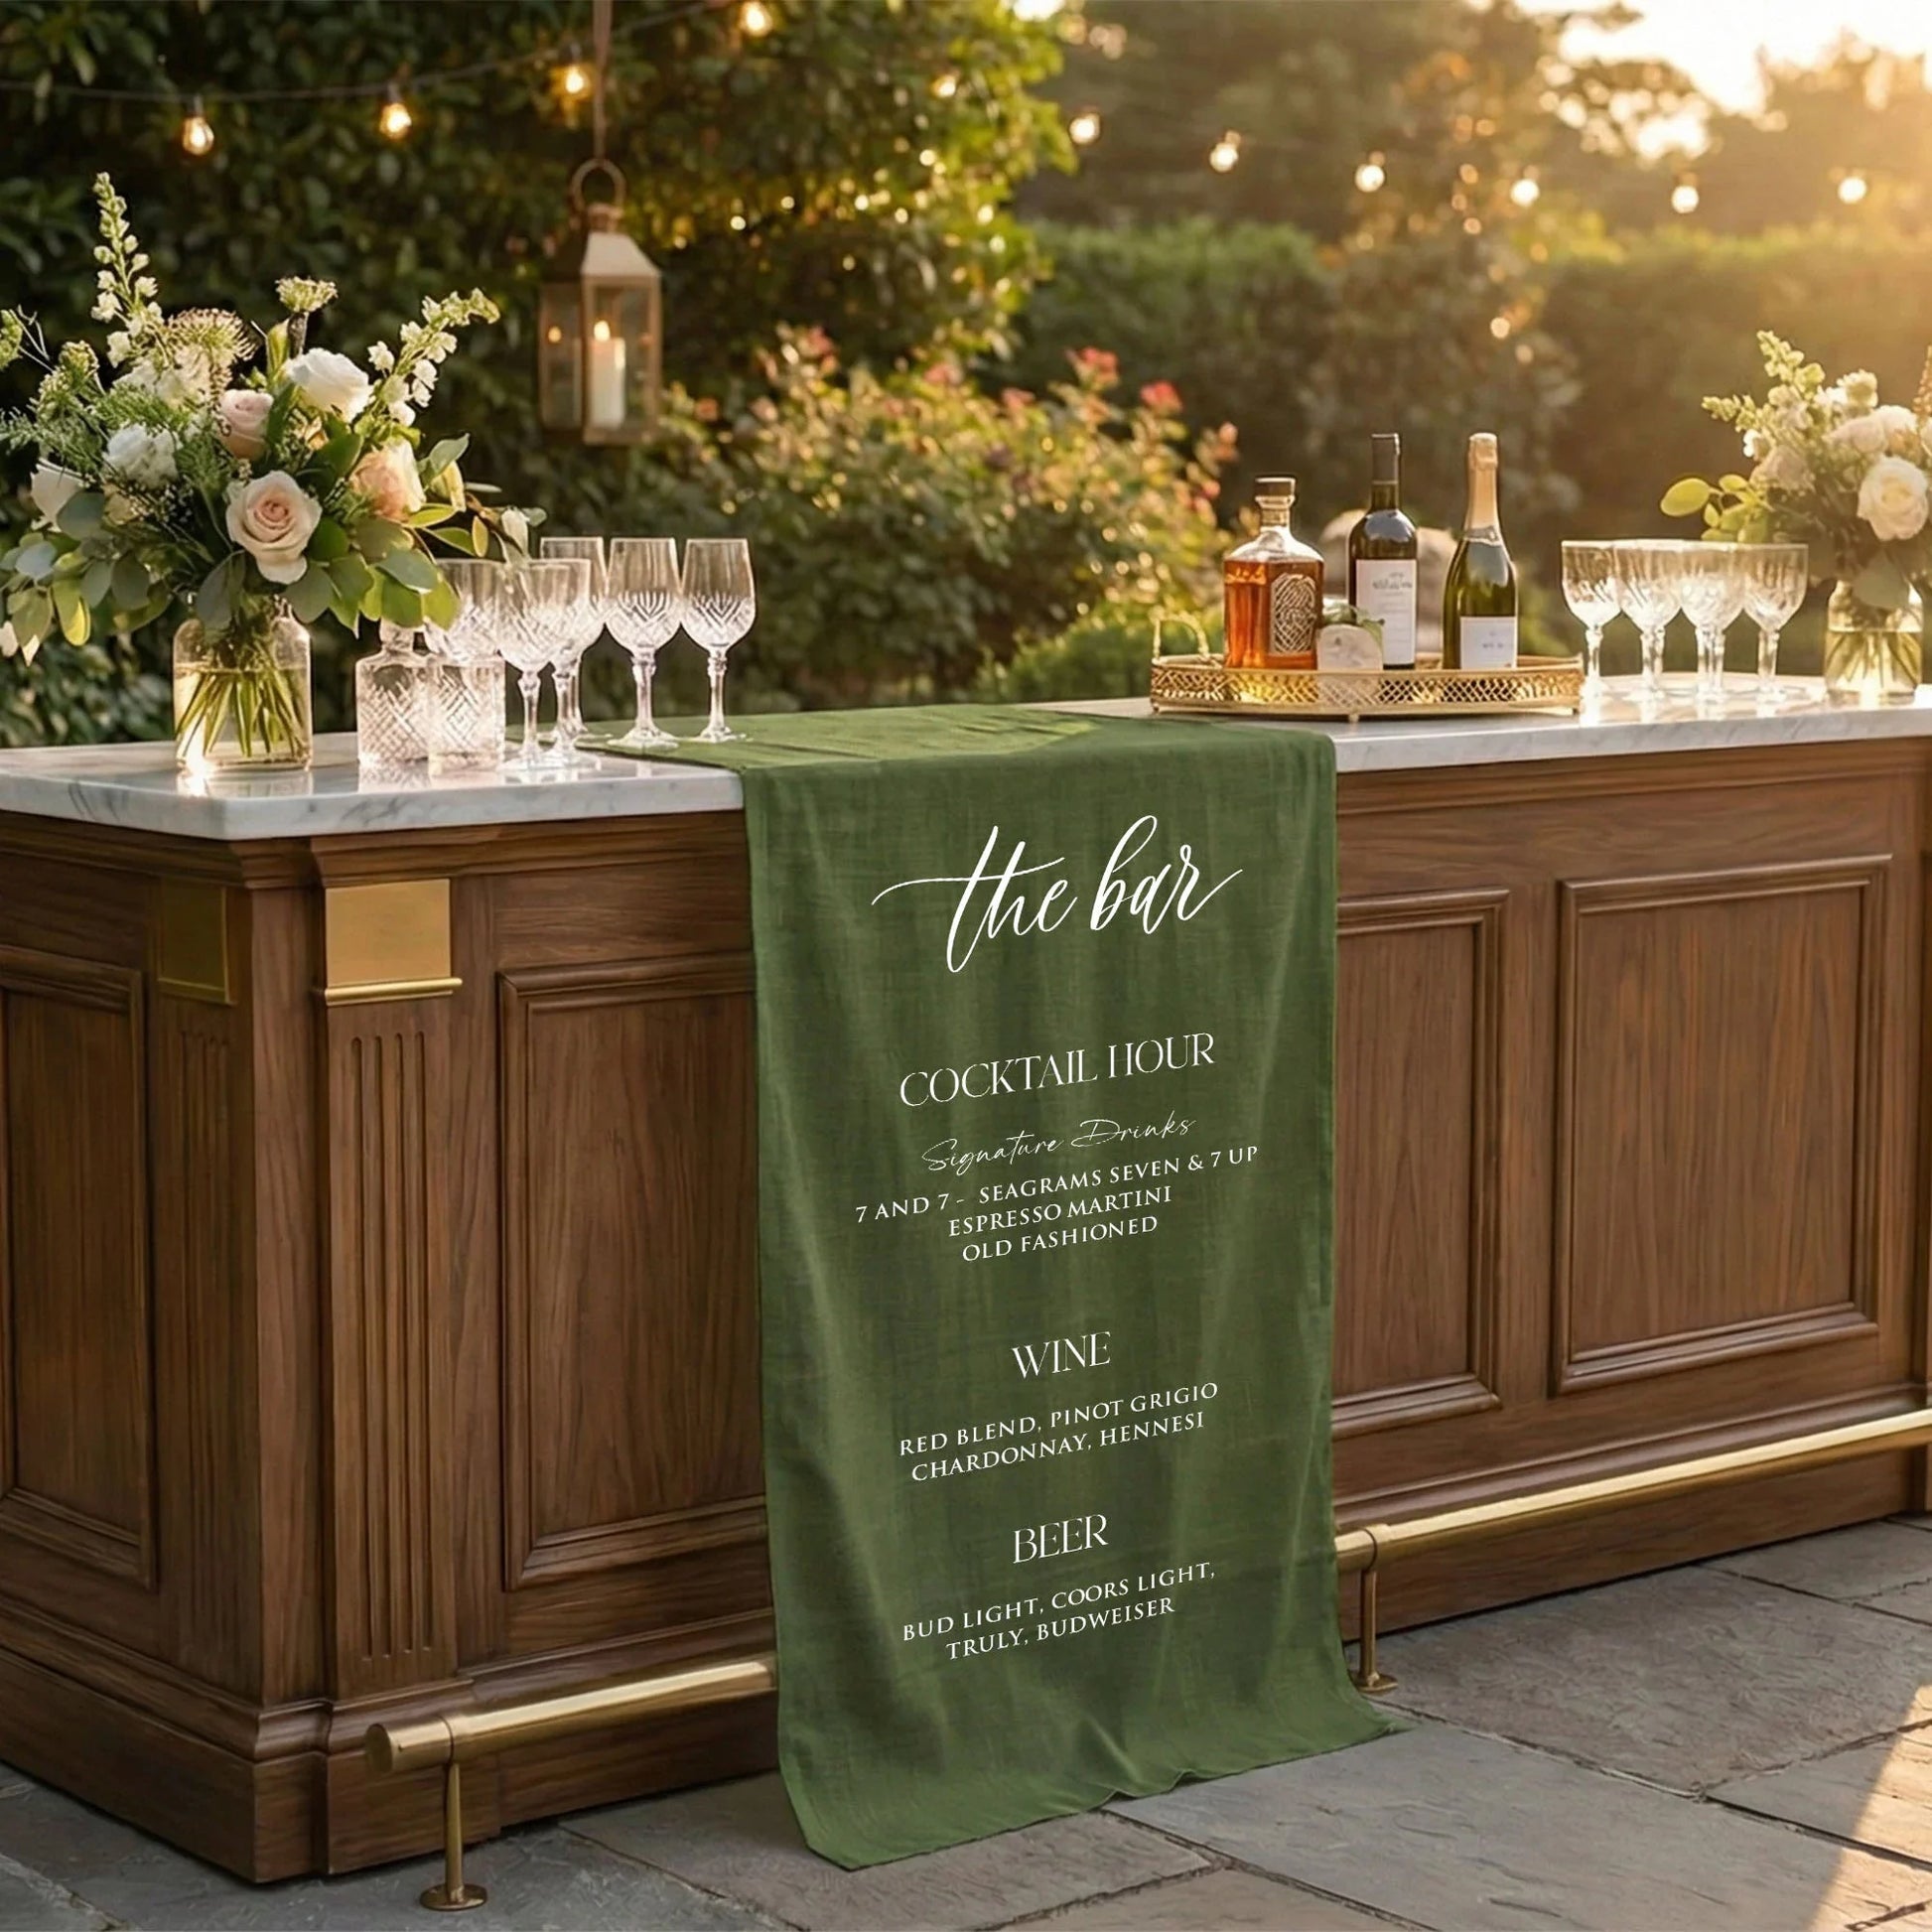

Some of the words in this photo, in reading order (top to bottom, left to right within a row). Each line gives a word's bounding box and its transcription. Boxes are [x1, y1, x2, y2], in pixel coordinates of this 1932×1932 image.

[871, 825, 1078, 974] the
[1089, 814, 1244, 935] bar
[899, 1048, 1098, 1107] COCKTAIL
[1108, 1032, 1214, 1079] HOUR
[921, 1130, 1062, 1176] Signature
[1070, 1110, 1194, 1148] Drinks
[855, 1205, 868, 1223] 7
[874, 1196, 930, 1220] AND
[979, 1169, 1101, 1204] SEAGRAMS
[1109, 1157, 1179, 1183] SEVEN
[1187, 1154, 1204, 1172] &
[1210, 1151, 1222, 1169] 7
[1228, 1146, 1258, 1165] UP
[948, 1203, 1062, 1237] ESPRESSO
[1066, 1185, 1172, 1218] MARTINI
[962, 1239, 1013, 1262] OLD
[1021, 1215, 1158, 1253] FASHIONED
[1012, 1330, 1111, 1379] WINE
[899, 1433, 948, 1456] RED
[957, 1416, 1041, 1446] BLEND,
[1050, 1399, 1124, 1428] PINOT
[1130, 1382, 1218, 1413] GRIGIO
[911, 1433, 1092, 1481] CHARDONNAY,
[1099, 1411, 1204, 1448] HENNESI
[1013, 1514, 1109, 1565] BEER
[902, 1616, 954, 1642] BUD
[963, 1597, 1043, 1629] LIGHT,
[1051, 1579, 1129, 1609] COORS
[1138, 1562, 1215, 1592] LIGHT,
[945, 1627, 1029, 1660] TRULY,
[1036, 1596, 1175, 1641] BUDWEISER
